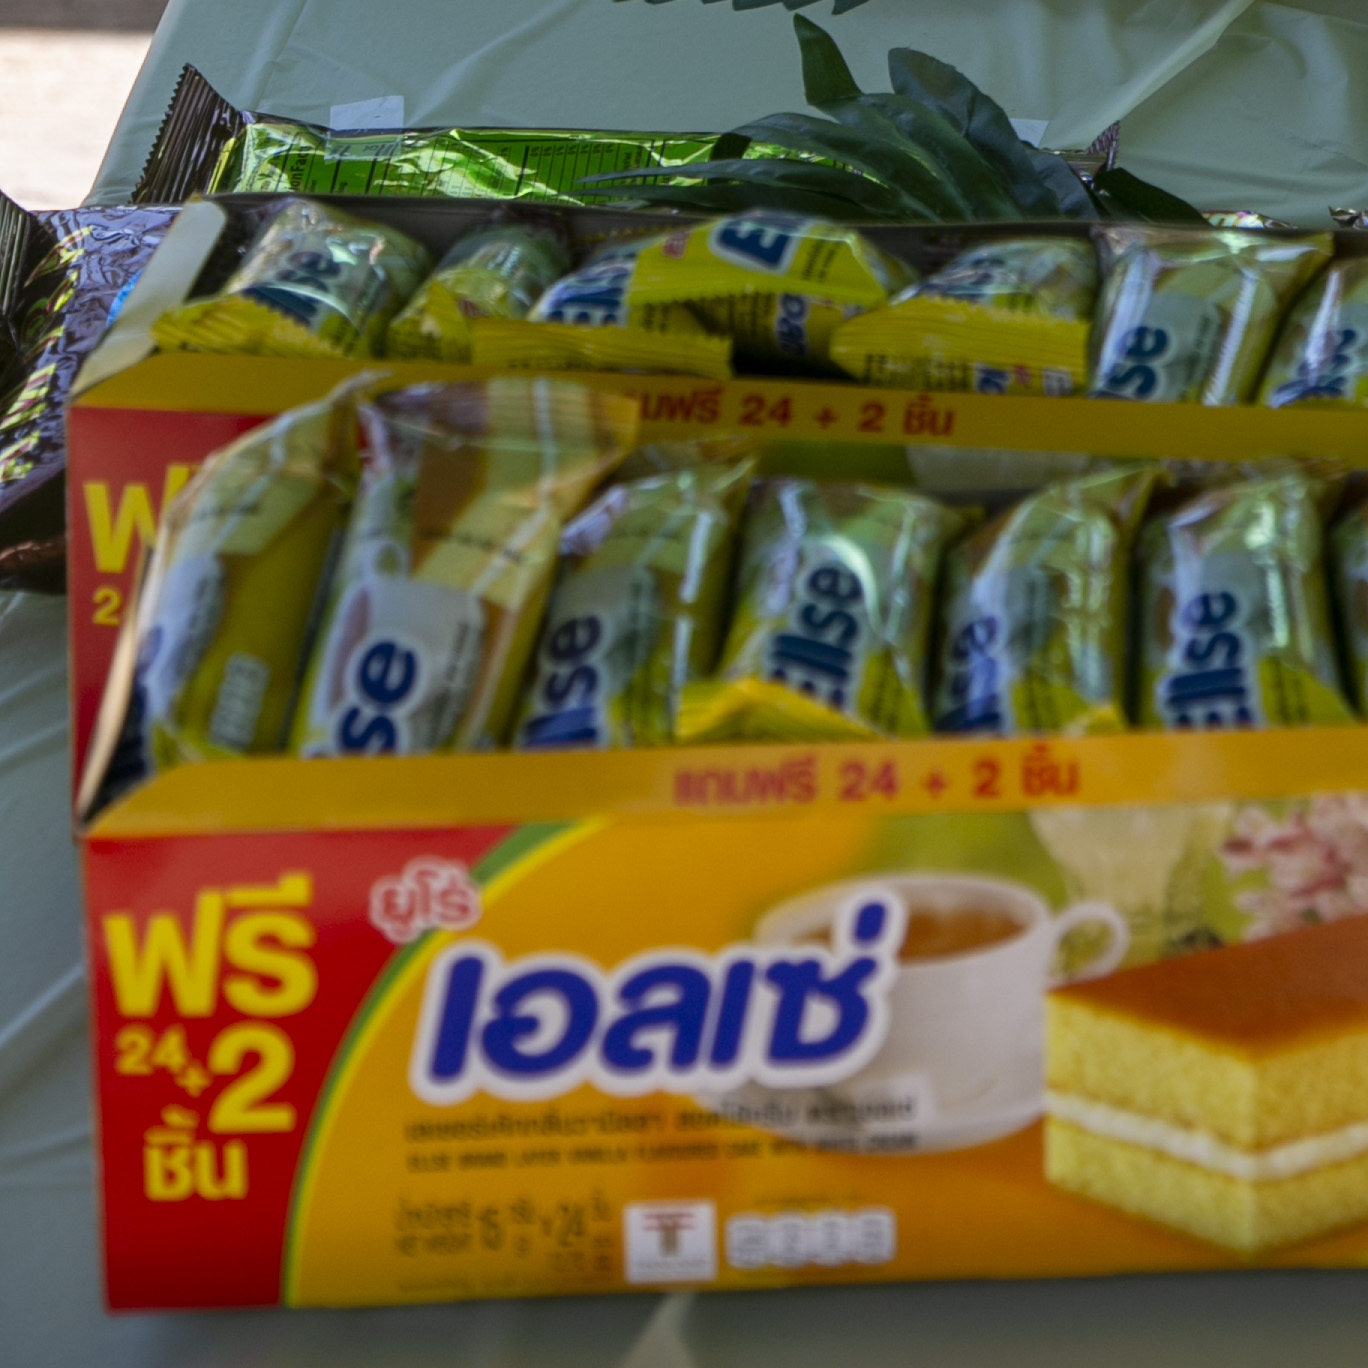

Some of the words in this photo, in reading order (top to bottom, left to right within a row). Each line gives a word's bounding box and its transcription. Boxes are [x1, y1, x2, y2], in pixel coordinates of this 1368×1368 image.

[738, 395, 793, 427] 24
[859, 401, 885, 432] 2
[838, 757, 899, 803] 24
[973, 755, 1000, 800] 2
[103, 870, 318, 1018] ฟรี
[425, 898, 887, 1086] เอลเซ่
[143, 1104, 249, 1202] ชิ้น
